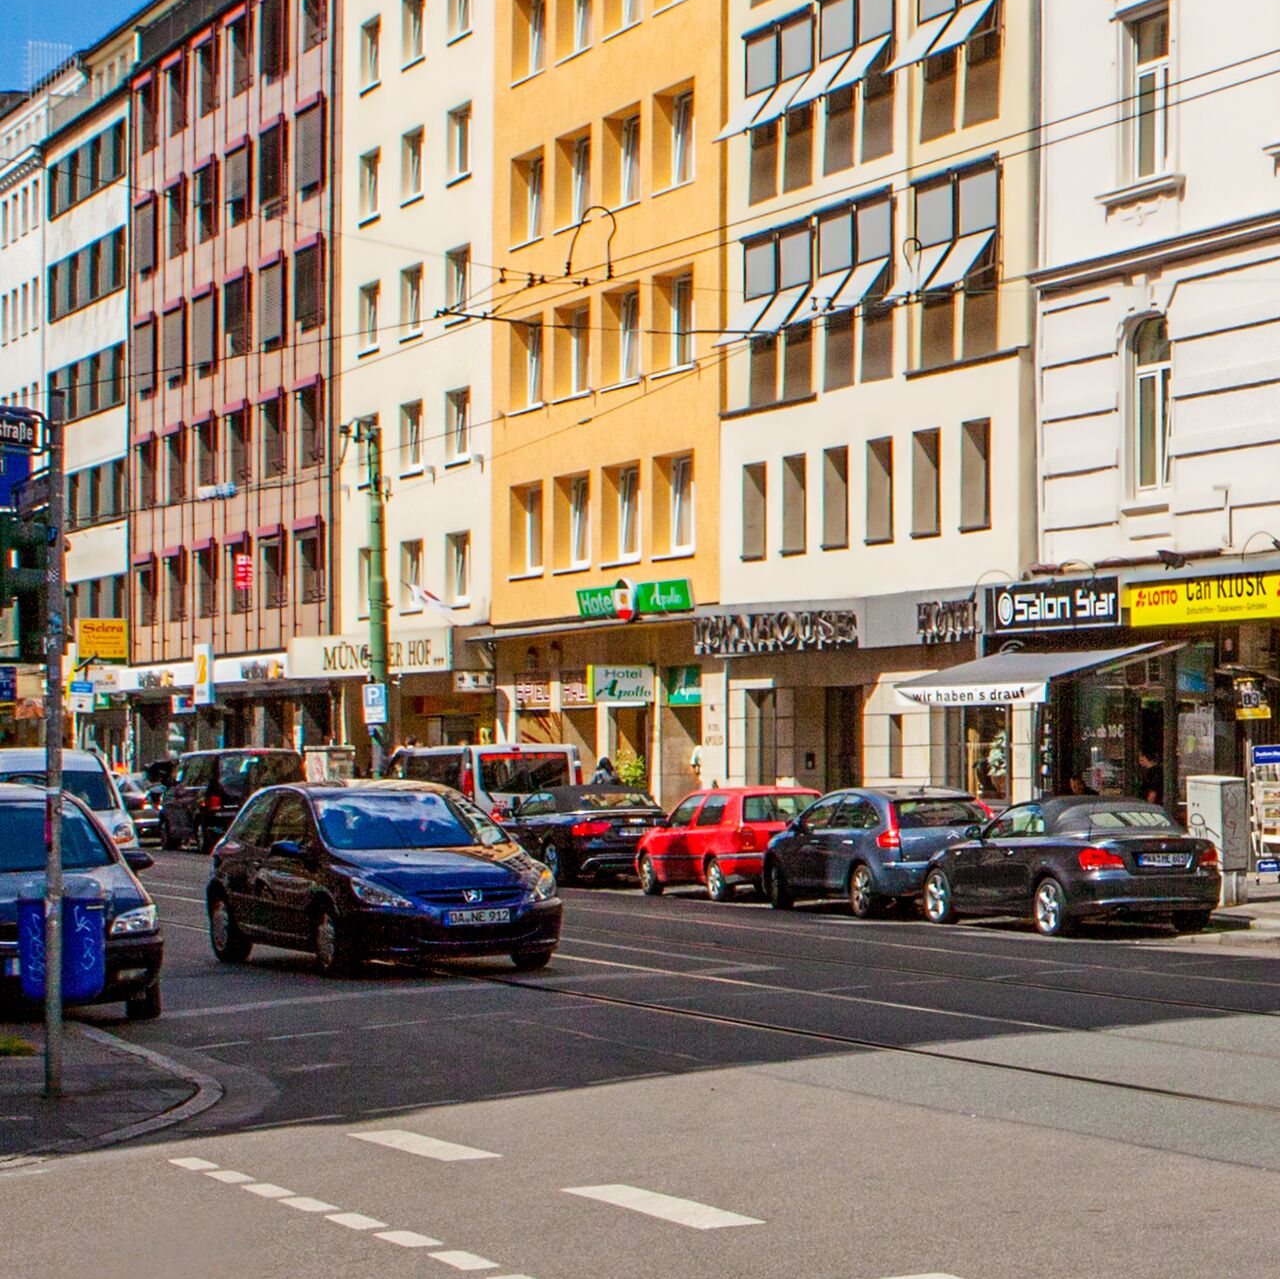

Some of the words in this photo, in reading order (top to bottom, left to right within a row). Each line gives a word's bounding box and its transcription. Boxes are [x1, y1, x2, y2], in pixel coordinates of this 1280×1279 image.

[1148, 589, 1178, 606] LOTTO
[1185, 577, 1211, 602] Can
[1217, 572, 1267, 599] KIOSK
[580, 589, 615, 614] Hotel
[1014, 591, 1071, 621] Salon
[1075, 588, 1117, 617] Star
[323, 641, 403, 671] MÜNCER
[408, 639, 431, 666] HOF
[605, 669, 642, 679] Hotel
[516, 681, 550, 703] SPIEL
[562, 681, 589, 702] HAL
[595, 679, 652, 700] Apollo
[913, 692, 931, 702] wir
[990, 687, 1025, 701] drauf
